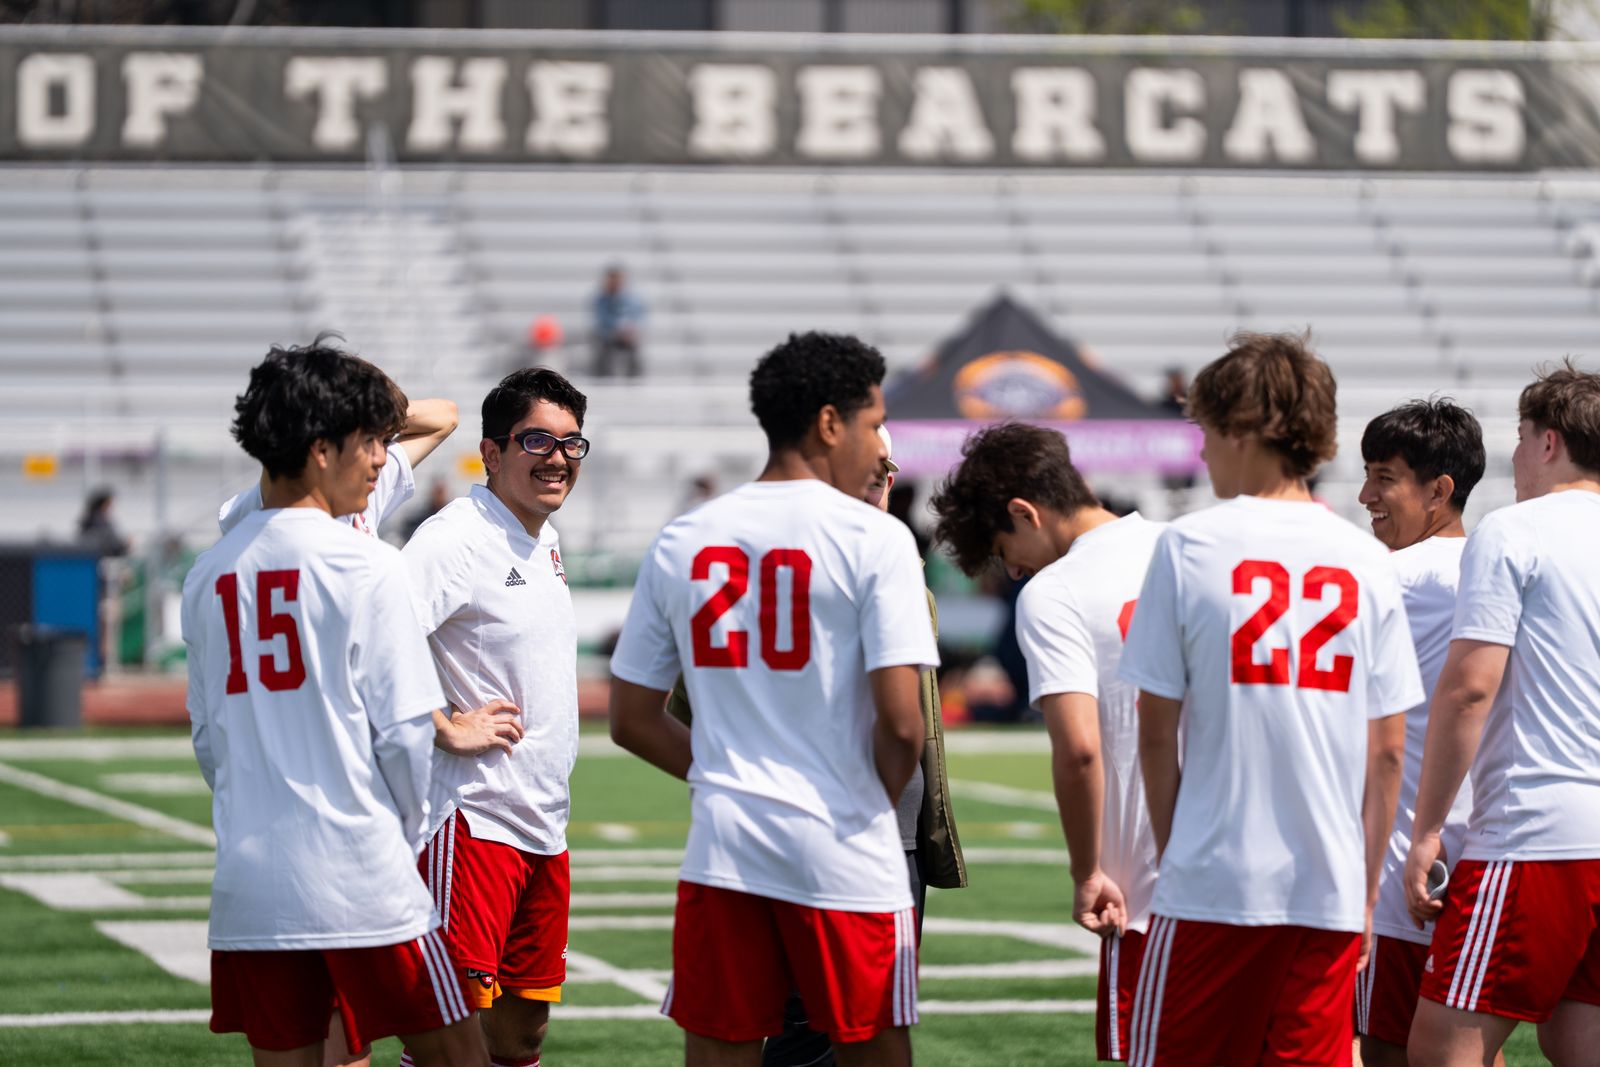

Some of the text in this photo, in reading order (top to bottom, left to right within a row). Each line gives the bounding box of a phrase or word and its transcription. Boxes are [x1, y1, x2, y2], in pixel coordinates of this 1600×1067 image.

[17, 53, 1527, 163] OF THE BEARCATS
[215, 569, 306, 694] 15
[505, 579, 526, 587] adidas
[690, 546, 813, 671] 20
[1231, 560, 1359, 692] 22
